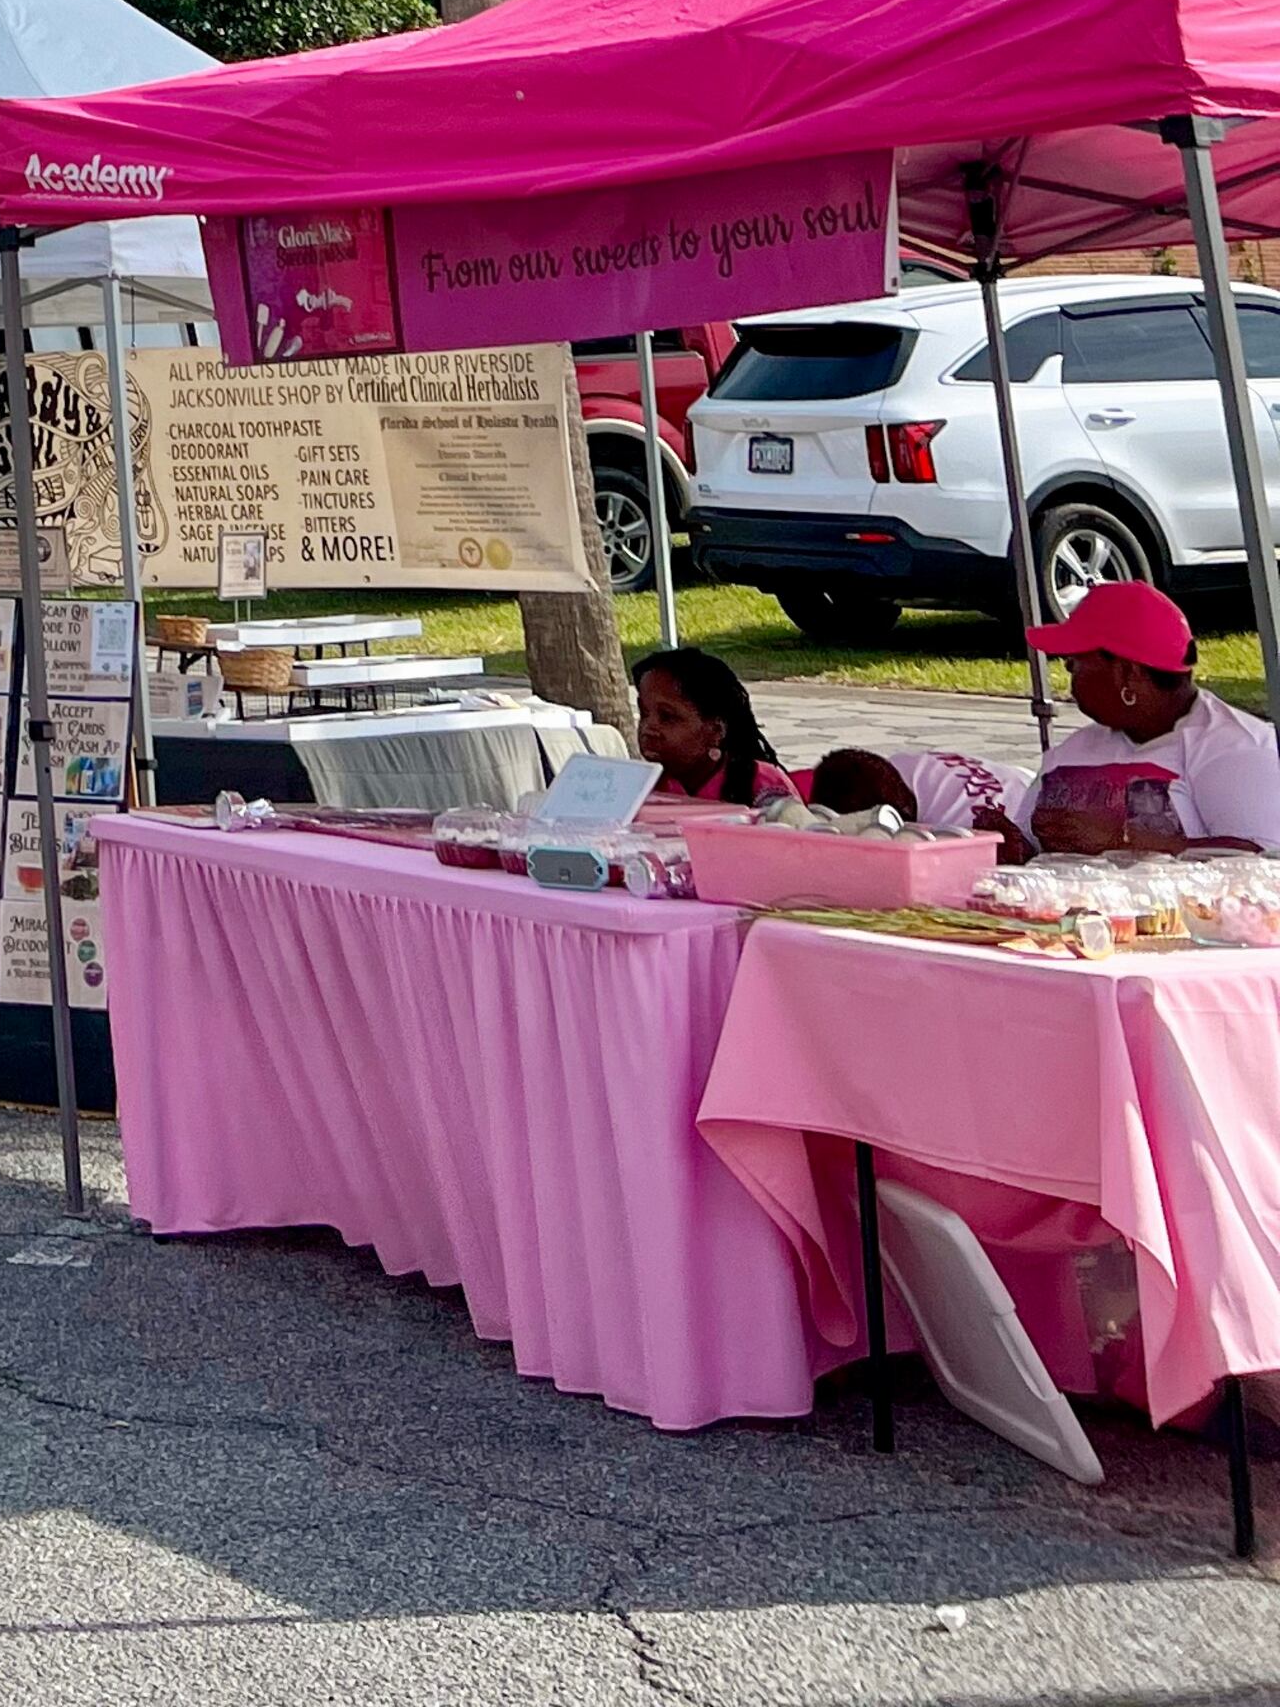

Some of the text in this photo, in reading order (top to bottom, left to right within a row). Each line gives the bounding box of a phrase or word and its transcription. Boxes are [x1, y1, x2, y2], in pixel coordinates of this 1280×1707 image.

[23, 153, 168, 201] Academy
[421, 181, 882, 292] From our sweets to your soul
[168, 361, 193, 382] ALL
[279, 359, 342, 379] LOCALLY
[345, 356, 391, 377] MADE
[394, 356, 412, 375] IN
[416, 355, 451, 375] OUR
[454, 352, 536, 374] RIVERSIDE
[169, 375, 541, 409] JACKSONVILLE SHOP BY Certified Clinical Herbalists
[239, 420, 323, 438] TOOTHPASTE
[329, 444, 360, 461] SETS
[240, 464, 269, 480] OILS
[335, 469, 371, 486] CARE
[237, 485, 280, 501] SOAPS
[231, 504, 265, 520] CARE
[301, 536, 395, 562] & MORE!
[42, 621, 64, 635] ODE
[51, 703, 95, 718] ACCEPT
